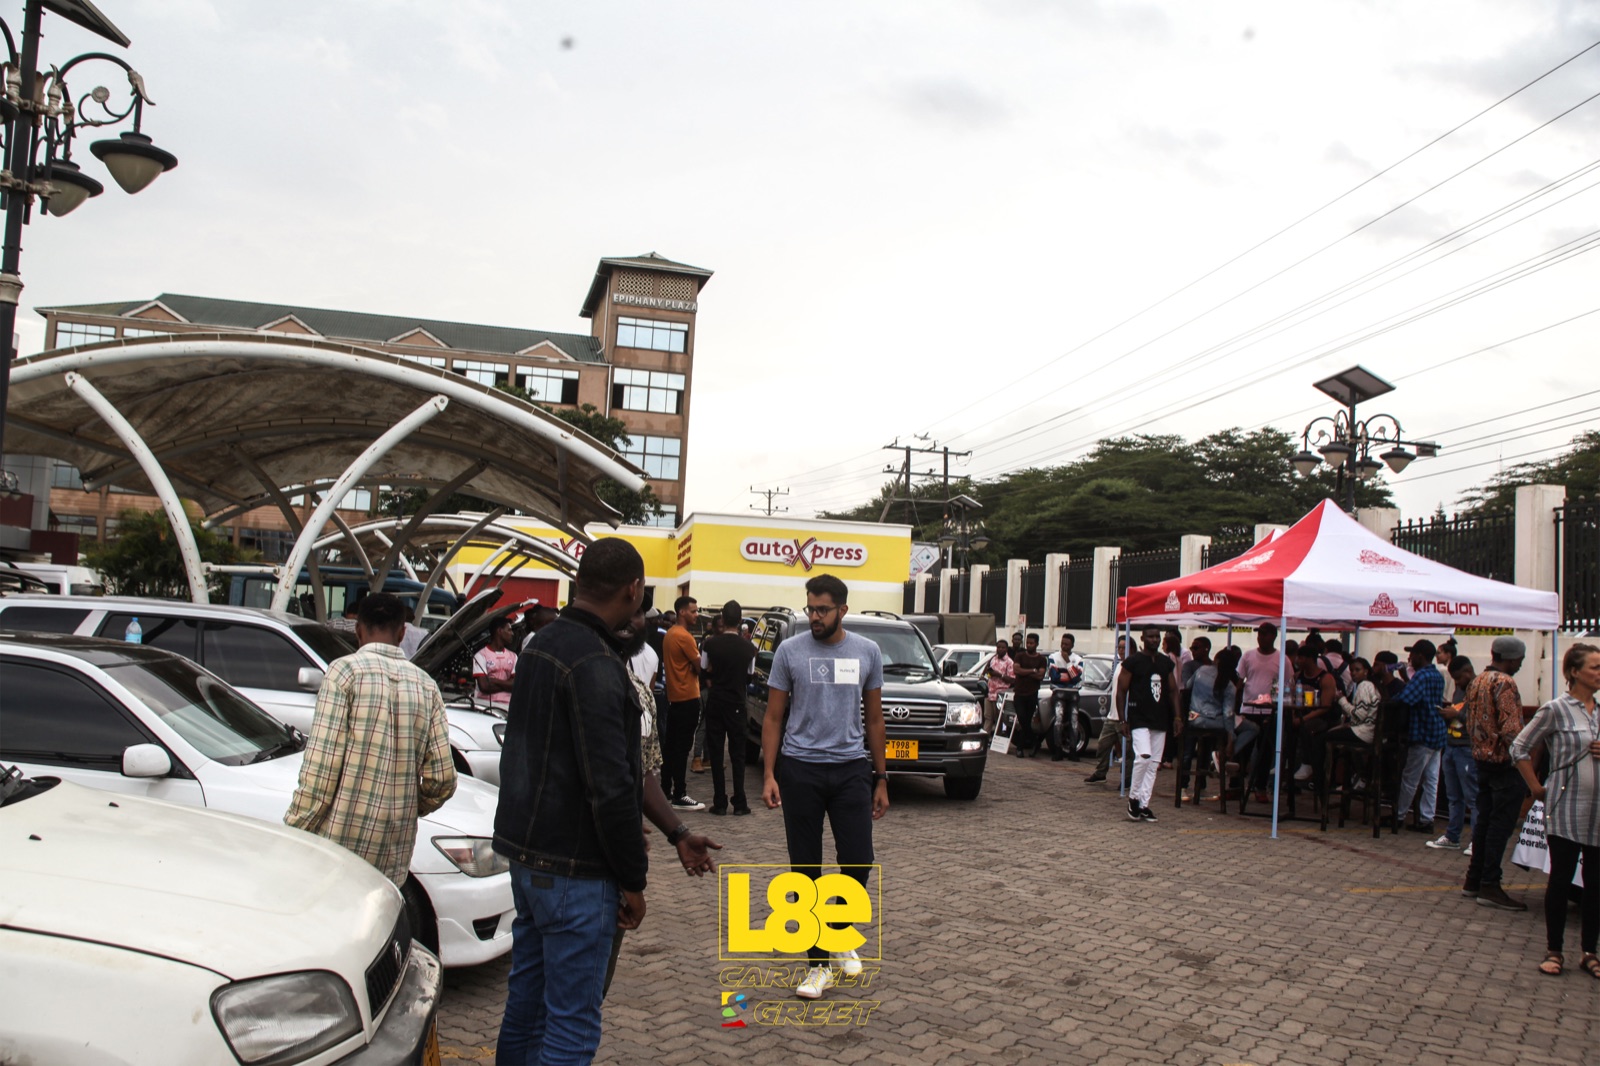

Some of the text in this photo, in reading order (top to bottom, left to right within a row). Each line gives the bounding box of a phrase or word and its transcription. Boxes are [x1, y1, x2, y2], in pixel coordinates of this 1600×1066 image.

[613, 294, 697, 311] EPIPHANY PLAZA
[1413, 600, 1479, 616] KINGLION
